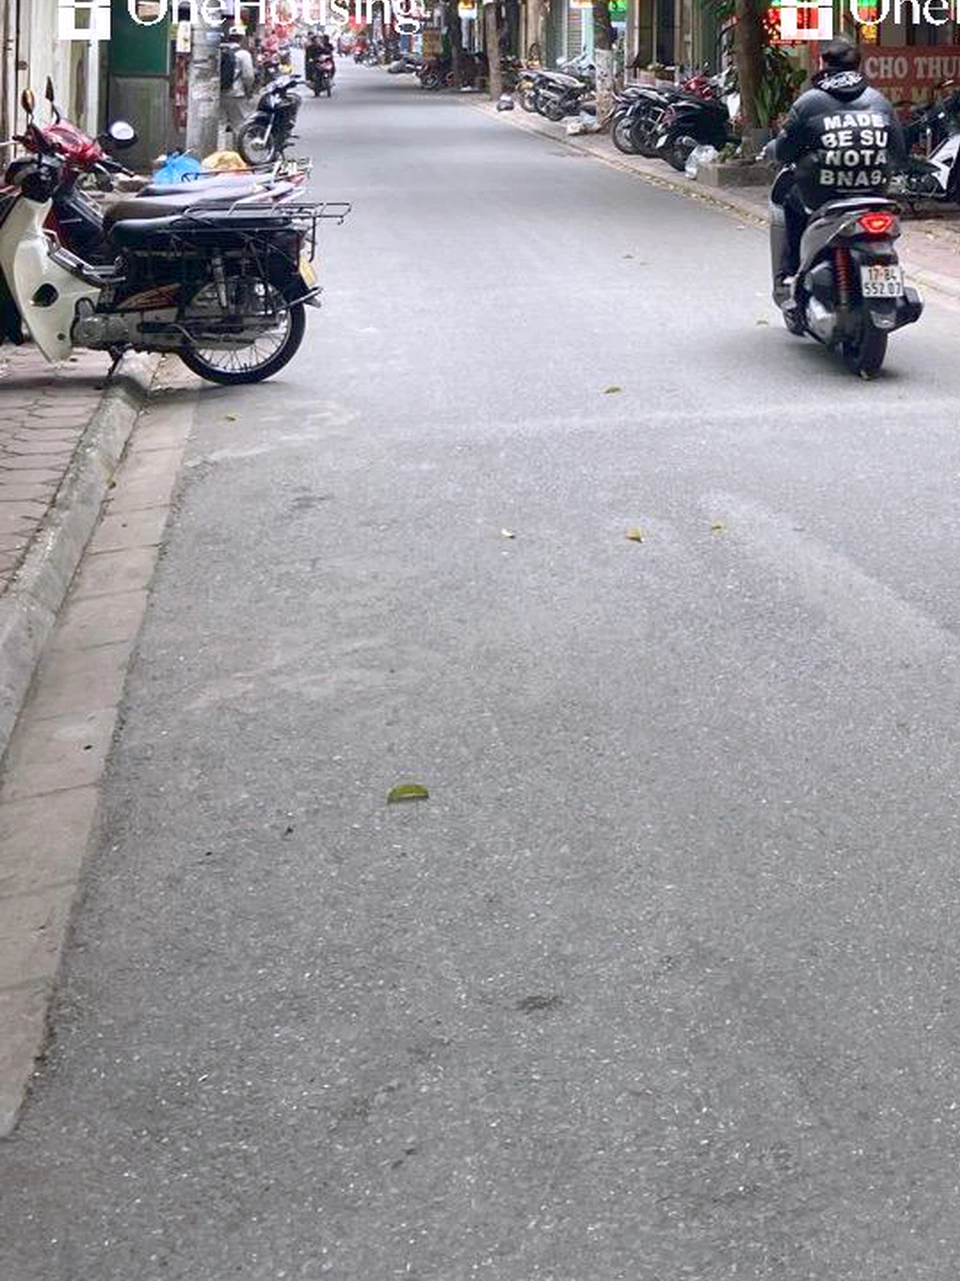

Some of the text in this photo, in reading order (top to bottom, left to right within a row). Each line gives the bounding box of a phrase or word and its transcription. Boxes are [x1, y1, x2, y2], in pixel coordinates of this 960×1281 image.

[864, 55, 909, 79] CHO
[823, 113, 886, 131] MADE
[821, 129, 888, 148] BE SU
